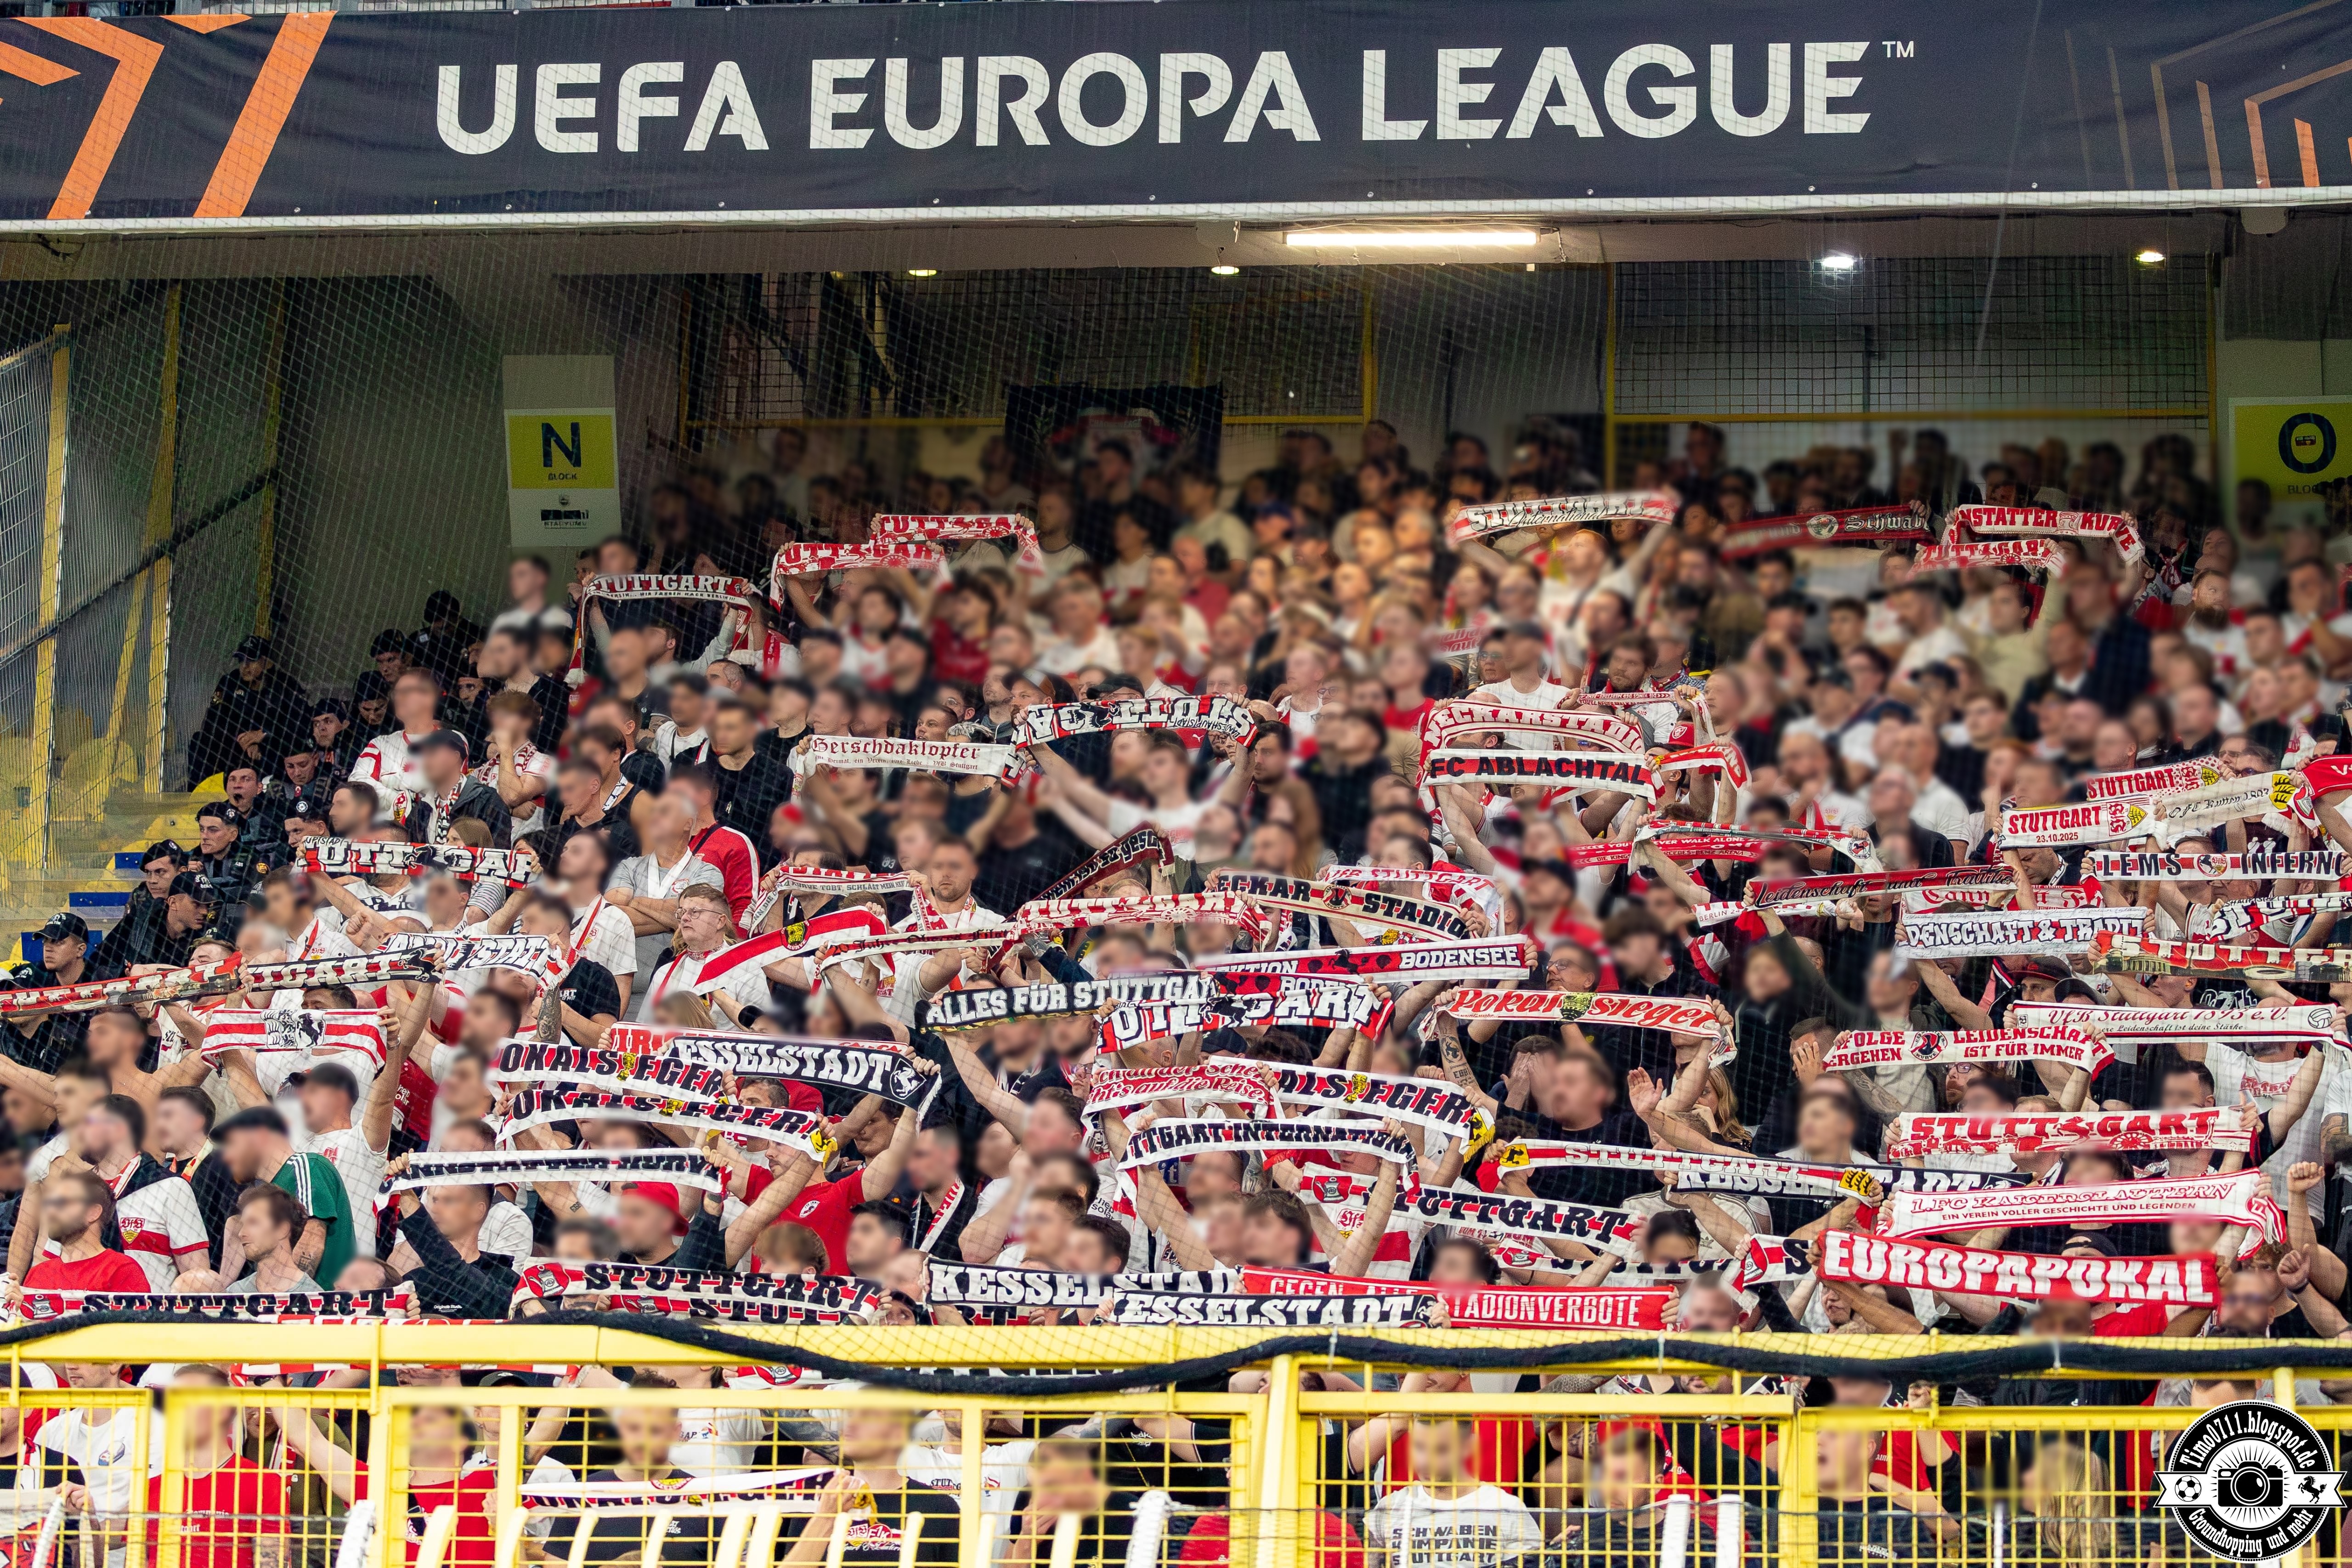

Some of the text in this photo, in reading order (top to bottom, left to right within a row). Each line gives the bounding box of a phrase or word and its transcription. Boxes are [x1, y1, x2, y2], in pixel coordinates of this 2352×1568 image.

[437, 60, 769, 155] UEFA
[810, 51, 1321, 150] EUROPA
[1362, 42, 1872, 141] LEAGUE
[542, 422, 582, 467] N
[2278, 413, 2337, 474] O
[1430, 756, 1465, 779] FC
[1475, 756, 1644, 785] ABLACHTAL
[2087, 767, 2176, 799] STUTTGART
[2008, 805, 2101, 835] STUTTGART
[2036, 832, 2079, 843] 23.10.2025
[1699, 910, 1727, 922] BERLIN
[1399, 945, 1521, 970] BODENSEE
[926, 990, 1008, 1025] ALLES
[1012, 982, 1068, 1013] FÜR
[1964, 1046, 1991, 1058] IST
[1996, 1041, 2027, 1057] FÜR
[2033, 1043, 2085, 1061] IMMER
[1565, 1144, 1811, 1181] STUTTGART
[1962, 1211, 1999, 1219] VEREIN
[2002, 1208, 2040, 1217] VOLLER
[2043, 1205, 2109, 1215] GESCHICHTE
[2139, 1202, 2196, 1211] LEGENDEN
[1825, 1231, 2214, 1305] EUROPAPOKAL
